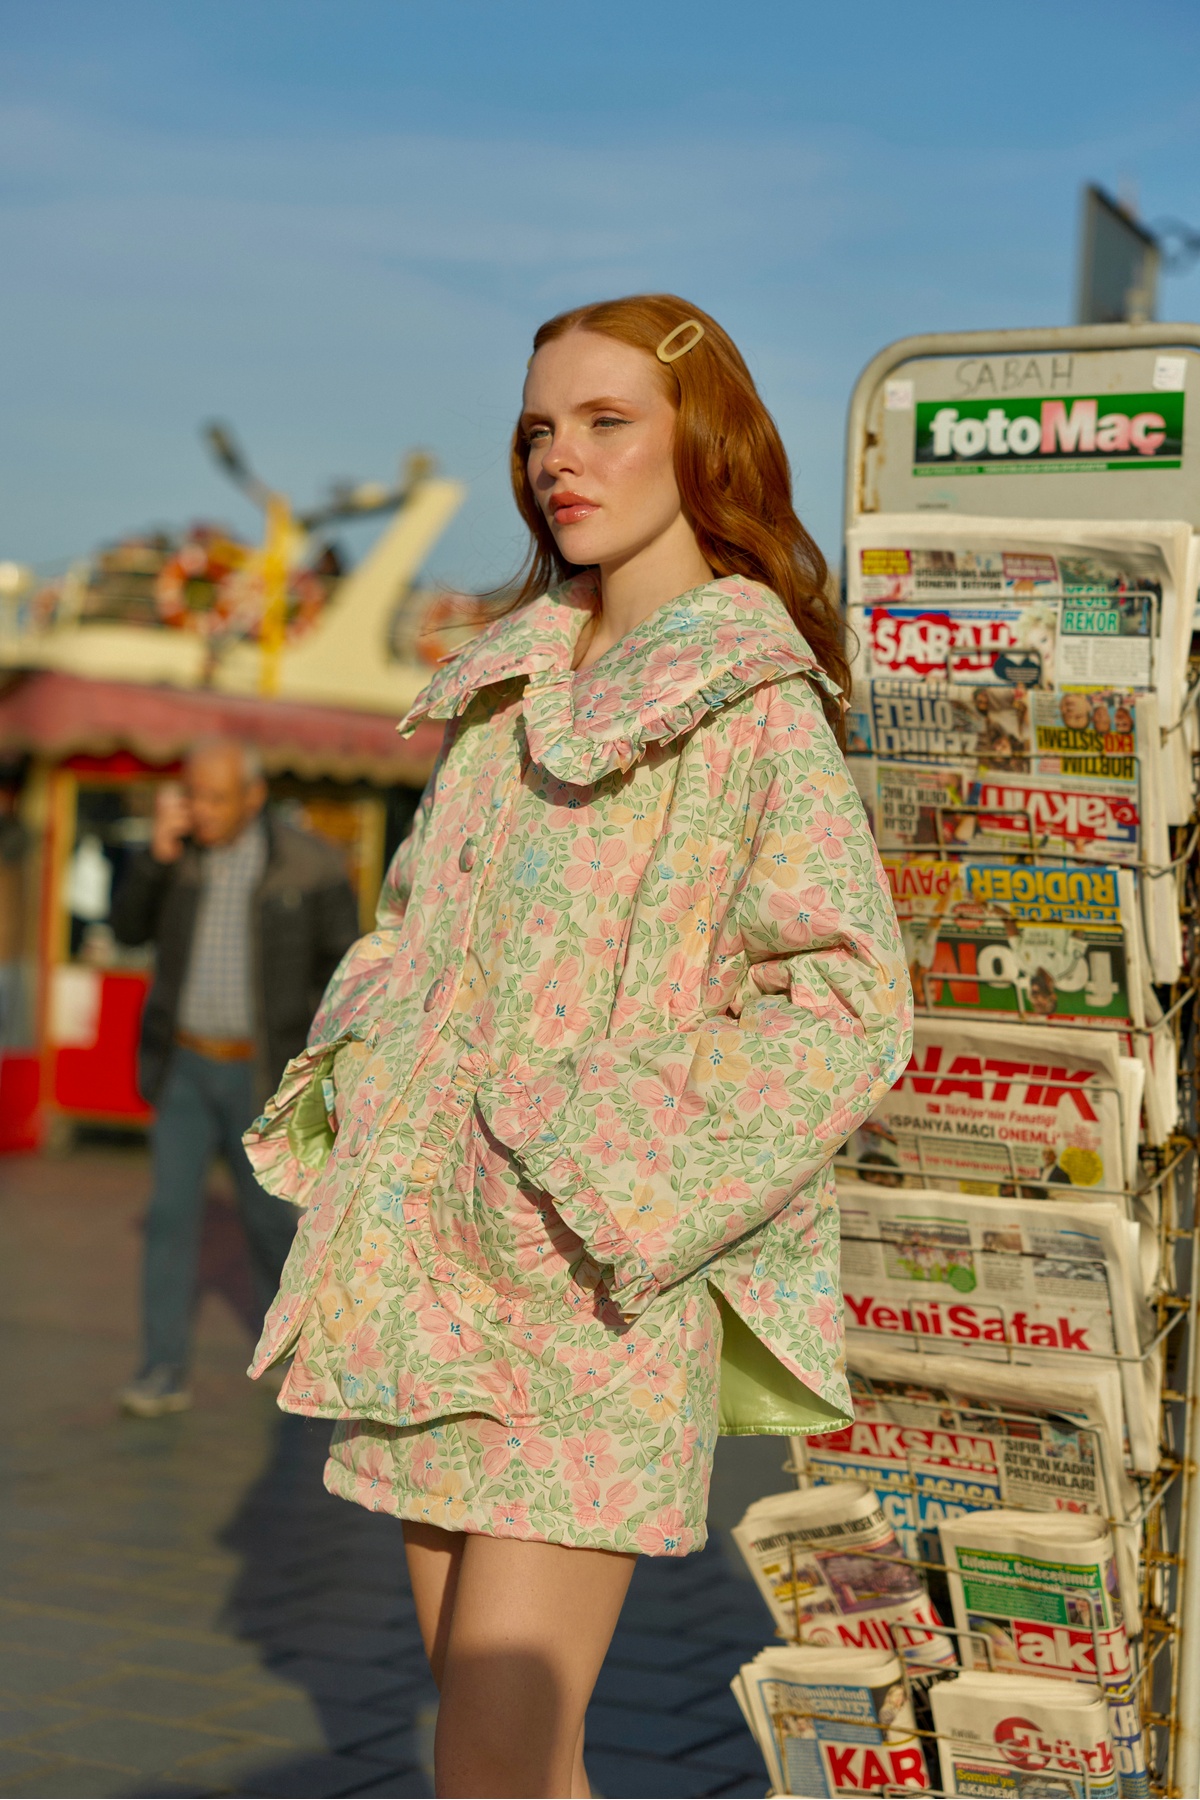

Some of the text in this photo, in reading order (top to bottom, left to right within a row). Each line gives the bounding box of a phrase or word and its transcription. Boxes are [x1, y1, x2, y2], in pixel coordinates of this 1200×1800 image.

[954, 358, 1075, 397] SABAH
[930, 400, 1167, 456] fotoMaç
[1063, 611, 1119, 633] REKOR
[875, 620, 1010, 667] SABAH
[875, 696, 953, 732] OTELE
[970, 868, 1116, 906] RÜDİGER
[844, 1294, 941, 1335] Yeni
[1005, 1464, 1096, 1492] PATRONLARI
[1018, 1627, 1131, 1674] akit
[826, 1745, 928, 1791] KAR
